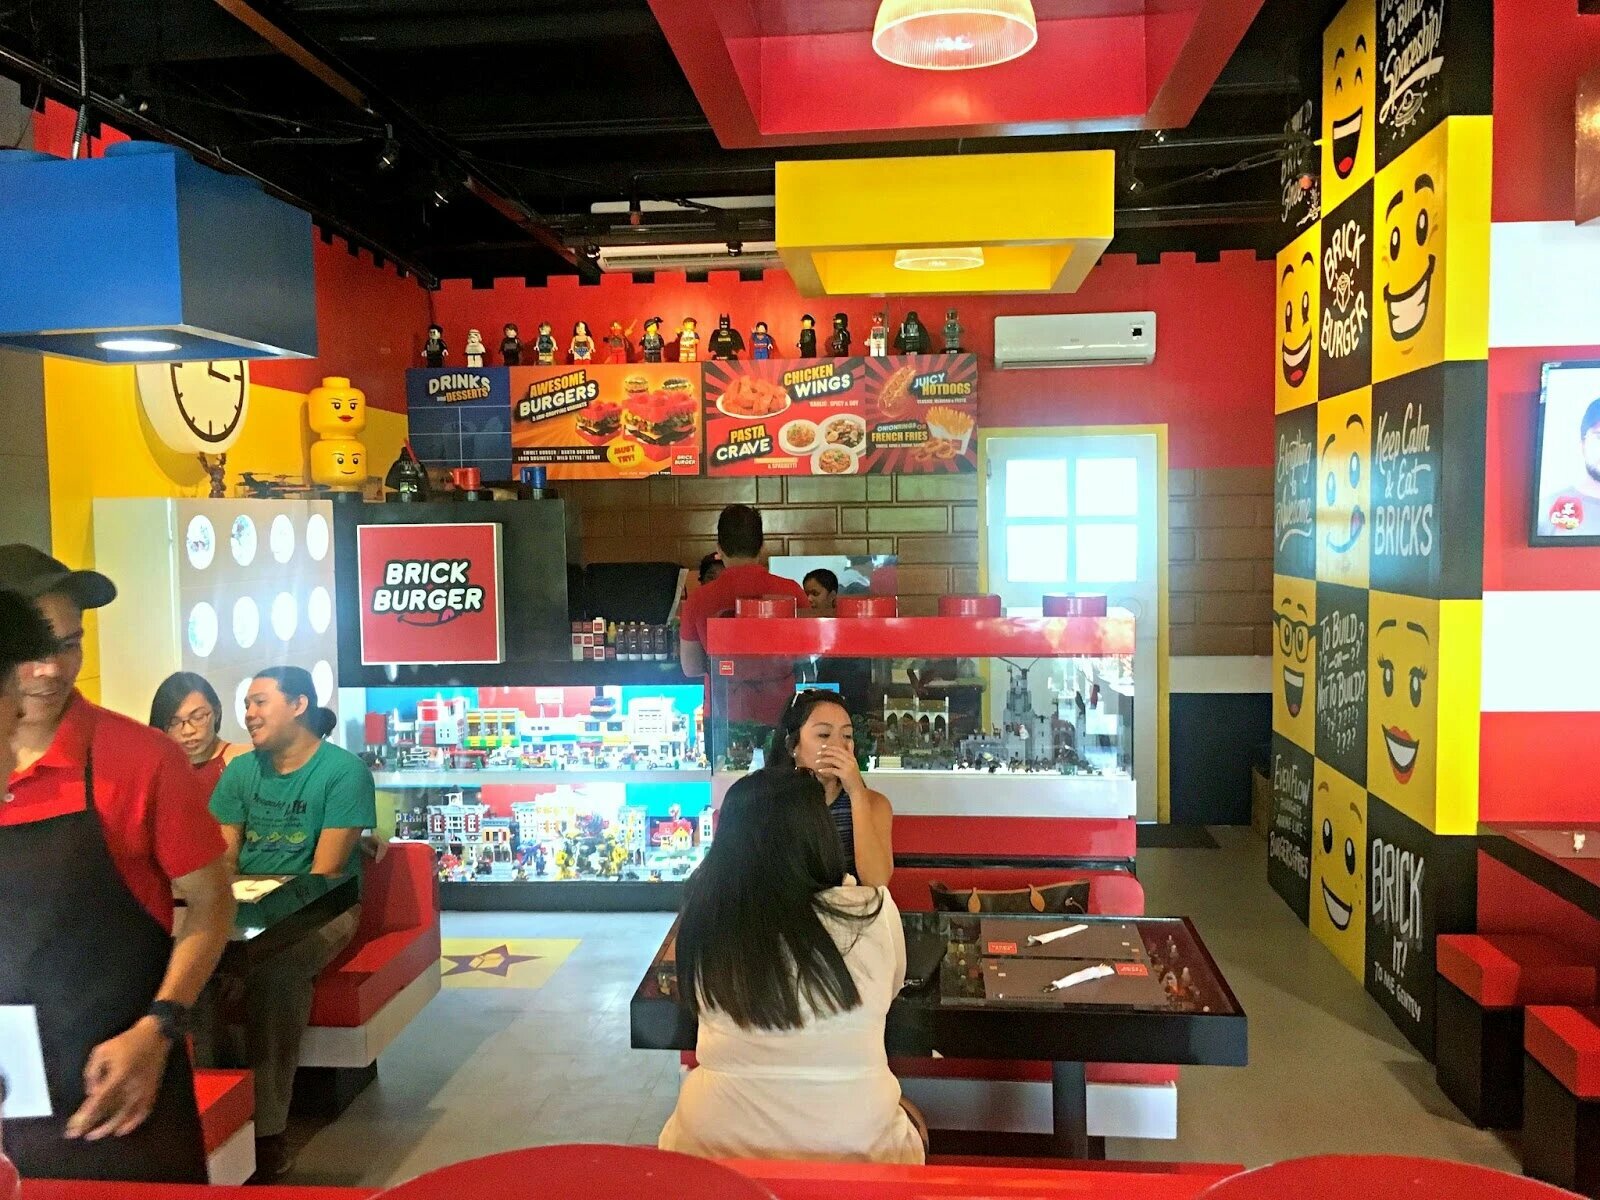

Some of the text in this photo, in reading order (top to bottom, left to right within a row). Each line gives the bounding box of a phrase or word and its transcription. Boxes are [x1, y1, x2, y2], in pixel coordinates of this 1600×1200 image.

[1324, 219, 1367, 290] BRICK
[1320, 290, 1368, 358] BURGER
[428, 373, 491, 395] DRINKS
[529, 370, 585, 399] AWESOME
[783, 363, 834, 386] CHICKEN
[793, 373, 851, 398] WINGS
[913, 372, 946, 388] JUICY
[445, 387, 489, 402] DESSERTS
[519, 382, 597, 418] BURGERS
[921, 382, 971, 396] HOTDOGS
[730, 425, 766, 444] PASTA
[871, 430, 929, 443] FRENCH FRIES
[1375, 402, 1431, 475] Keep Calm
[613, 444, 636, 455] MUST
[616, 454, 636, 464] TRY!
[716, 438, 771, 461] CRAVE
[1384, 458, 1431, 500] & Eat
[1374, 503, 1433, 557] BRICKS
[385, 561, 469, 585] BRICK
[373, 587, 484, 611] BURGER
[1372, 837, 1424, 940] BRICK
[1392, 935, 1408, 979] IT!
